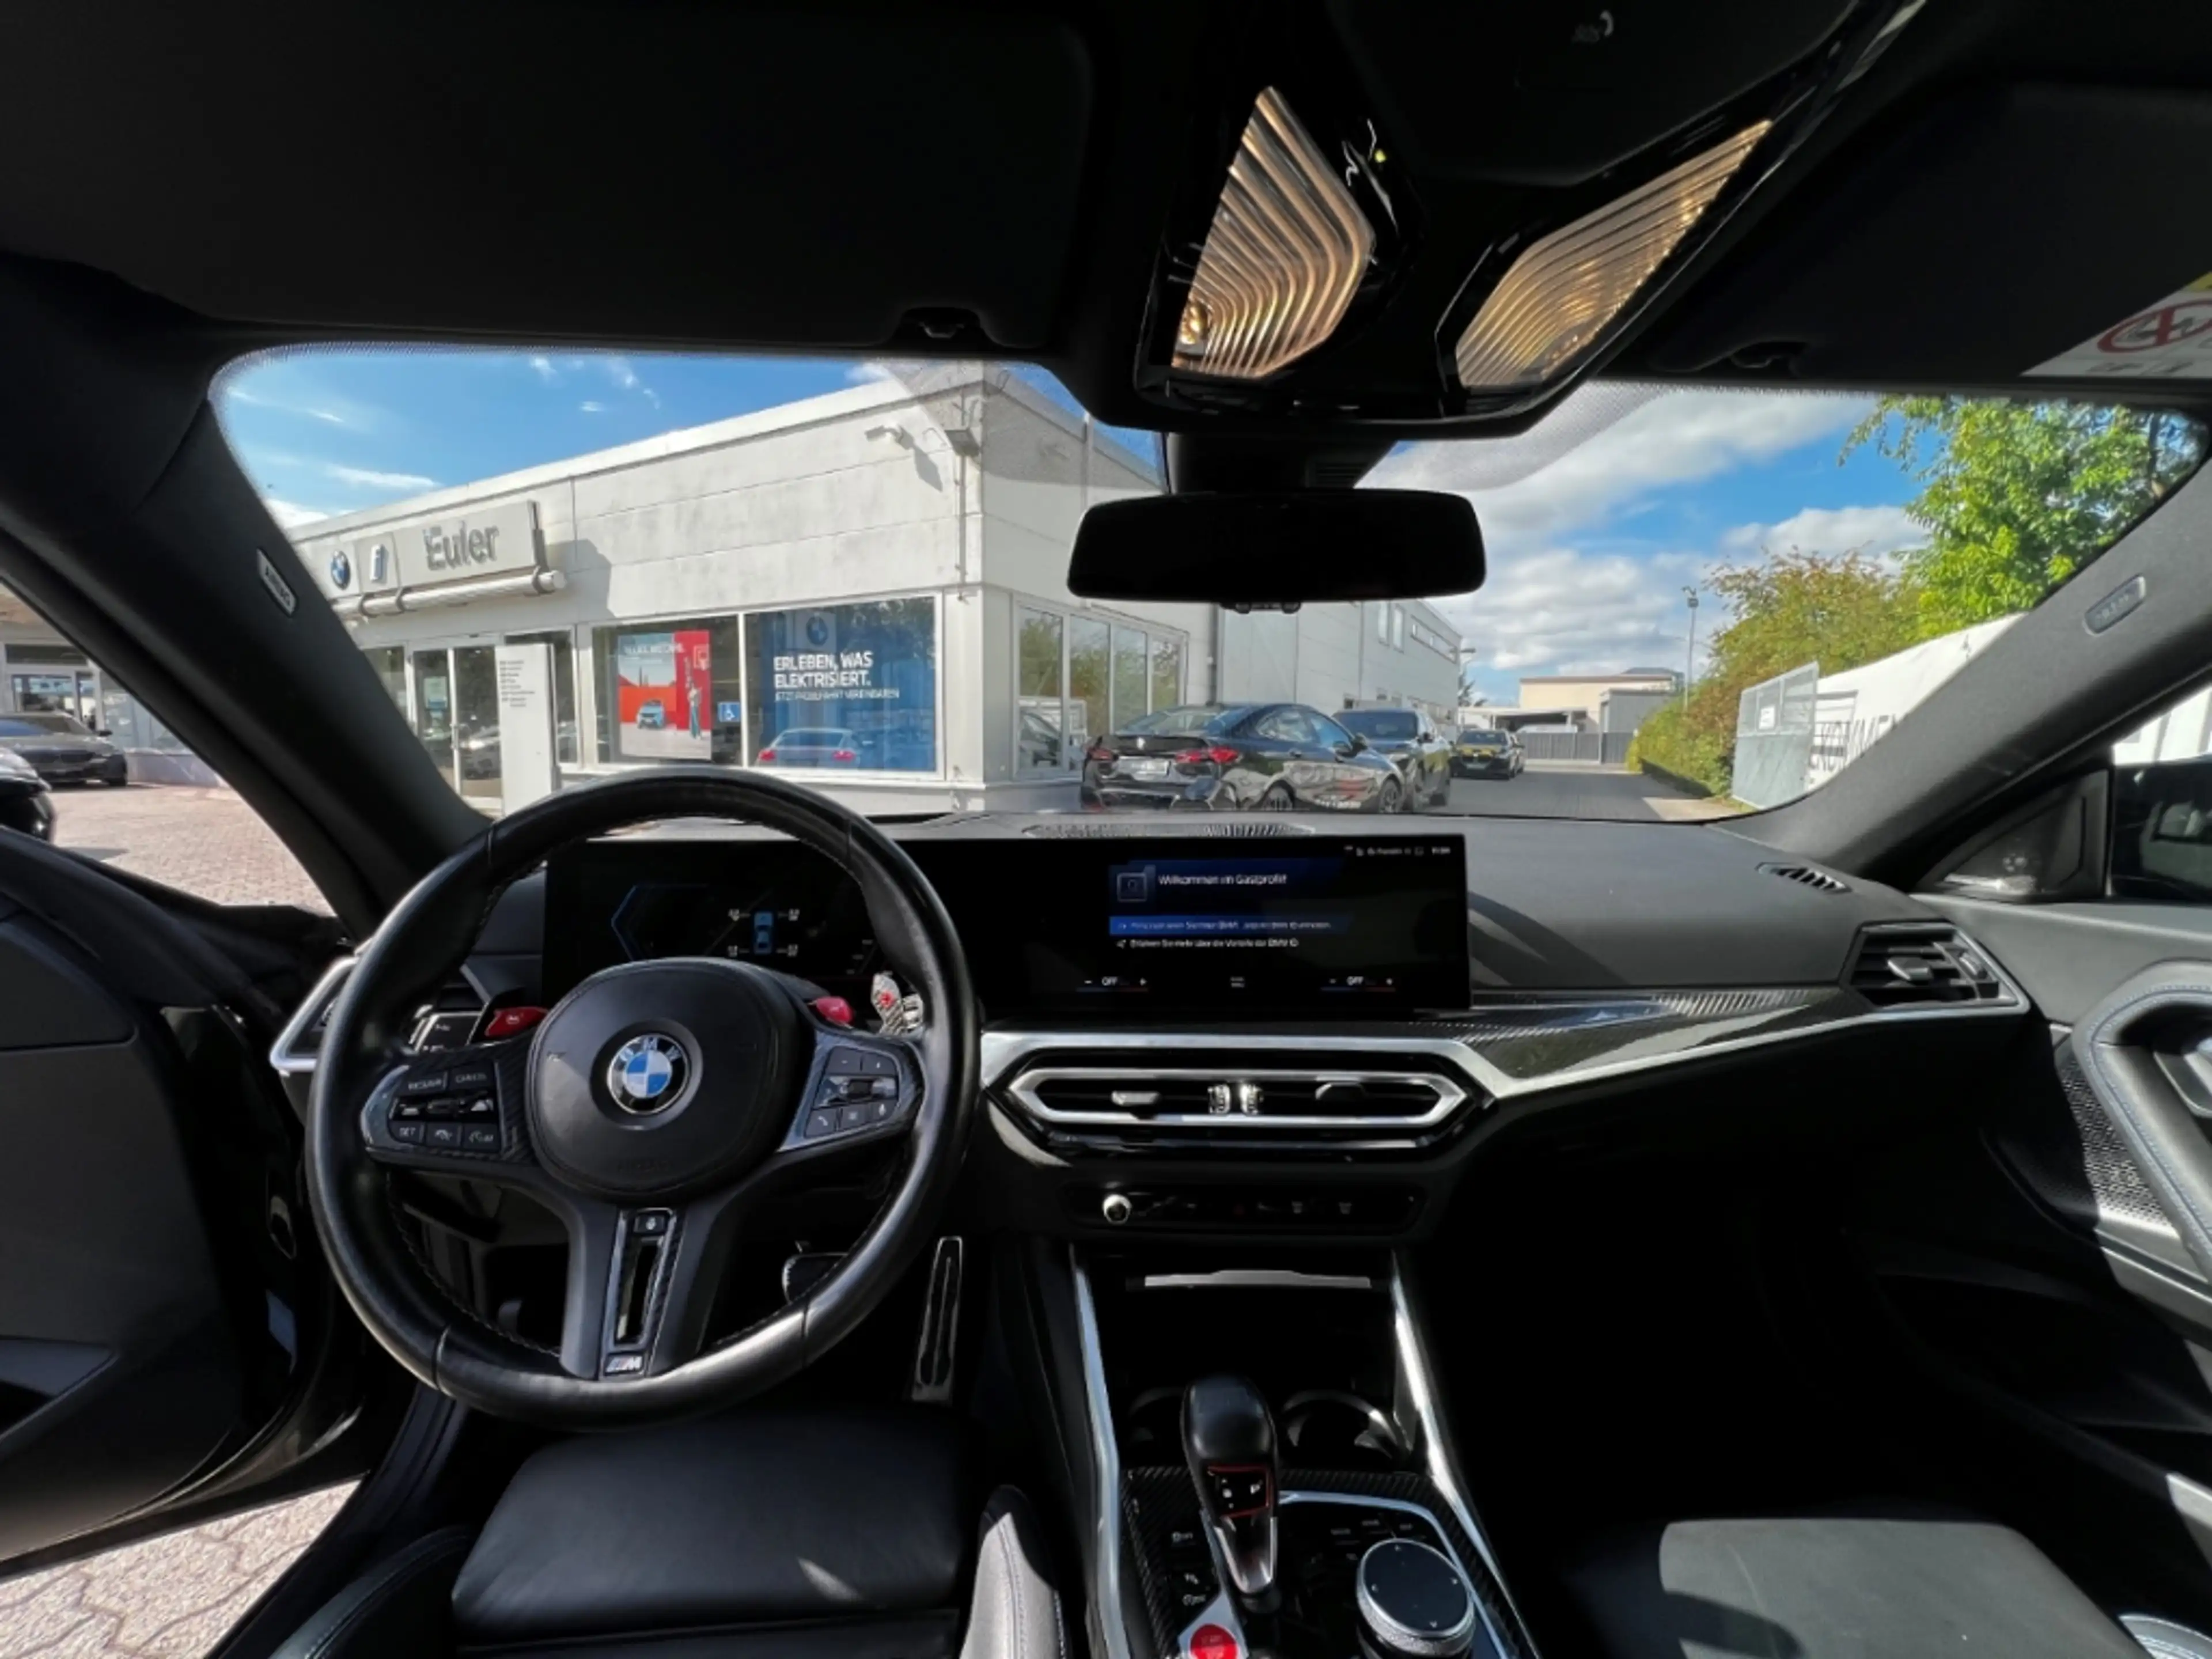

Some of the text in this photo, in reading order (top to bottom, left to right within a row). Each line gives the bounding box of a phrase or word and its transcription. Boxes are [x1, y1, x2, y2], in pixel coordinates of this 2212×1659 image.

[423, 520, 499, 571] Euler
[773, 650, 874, 671] ERLEBEN, WAS
[774, 669, 872, 688] ELEKTRISIERT.
[1101, 976, 1118, 986] OFF
[1347, 976, 1363, 986] OFF
